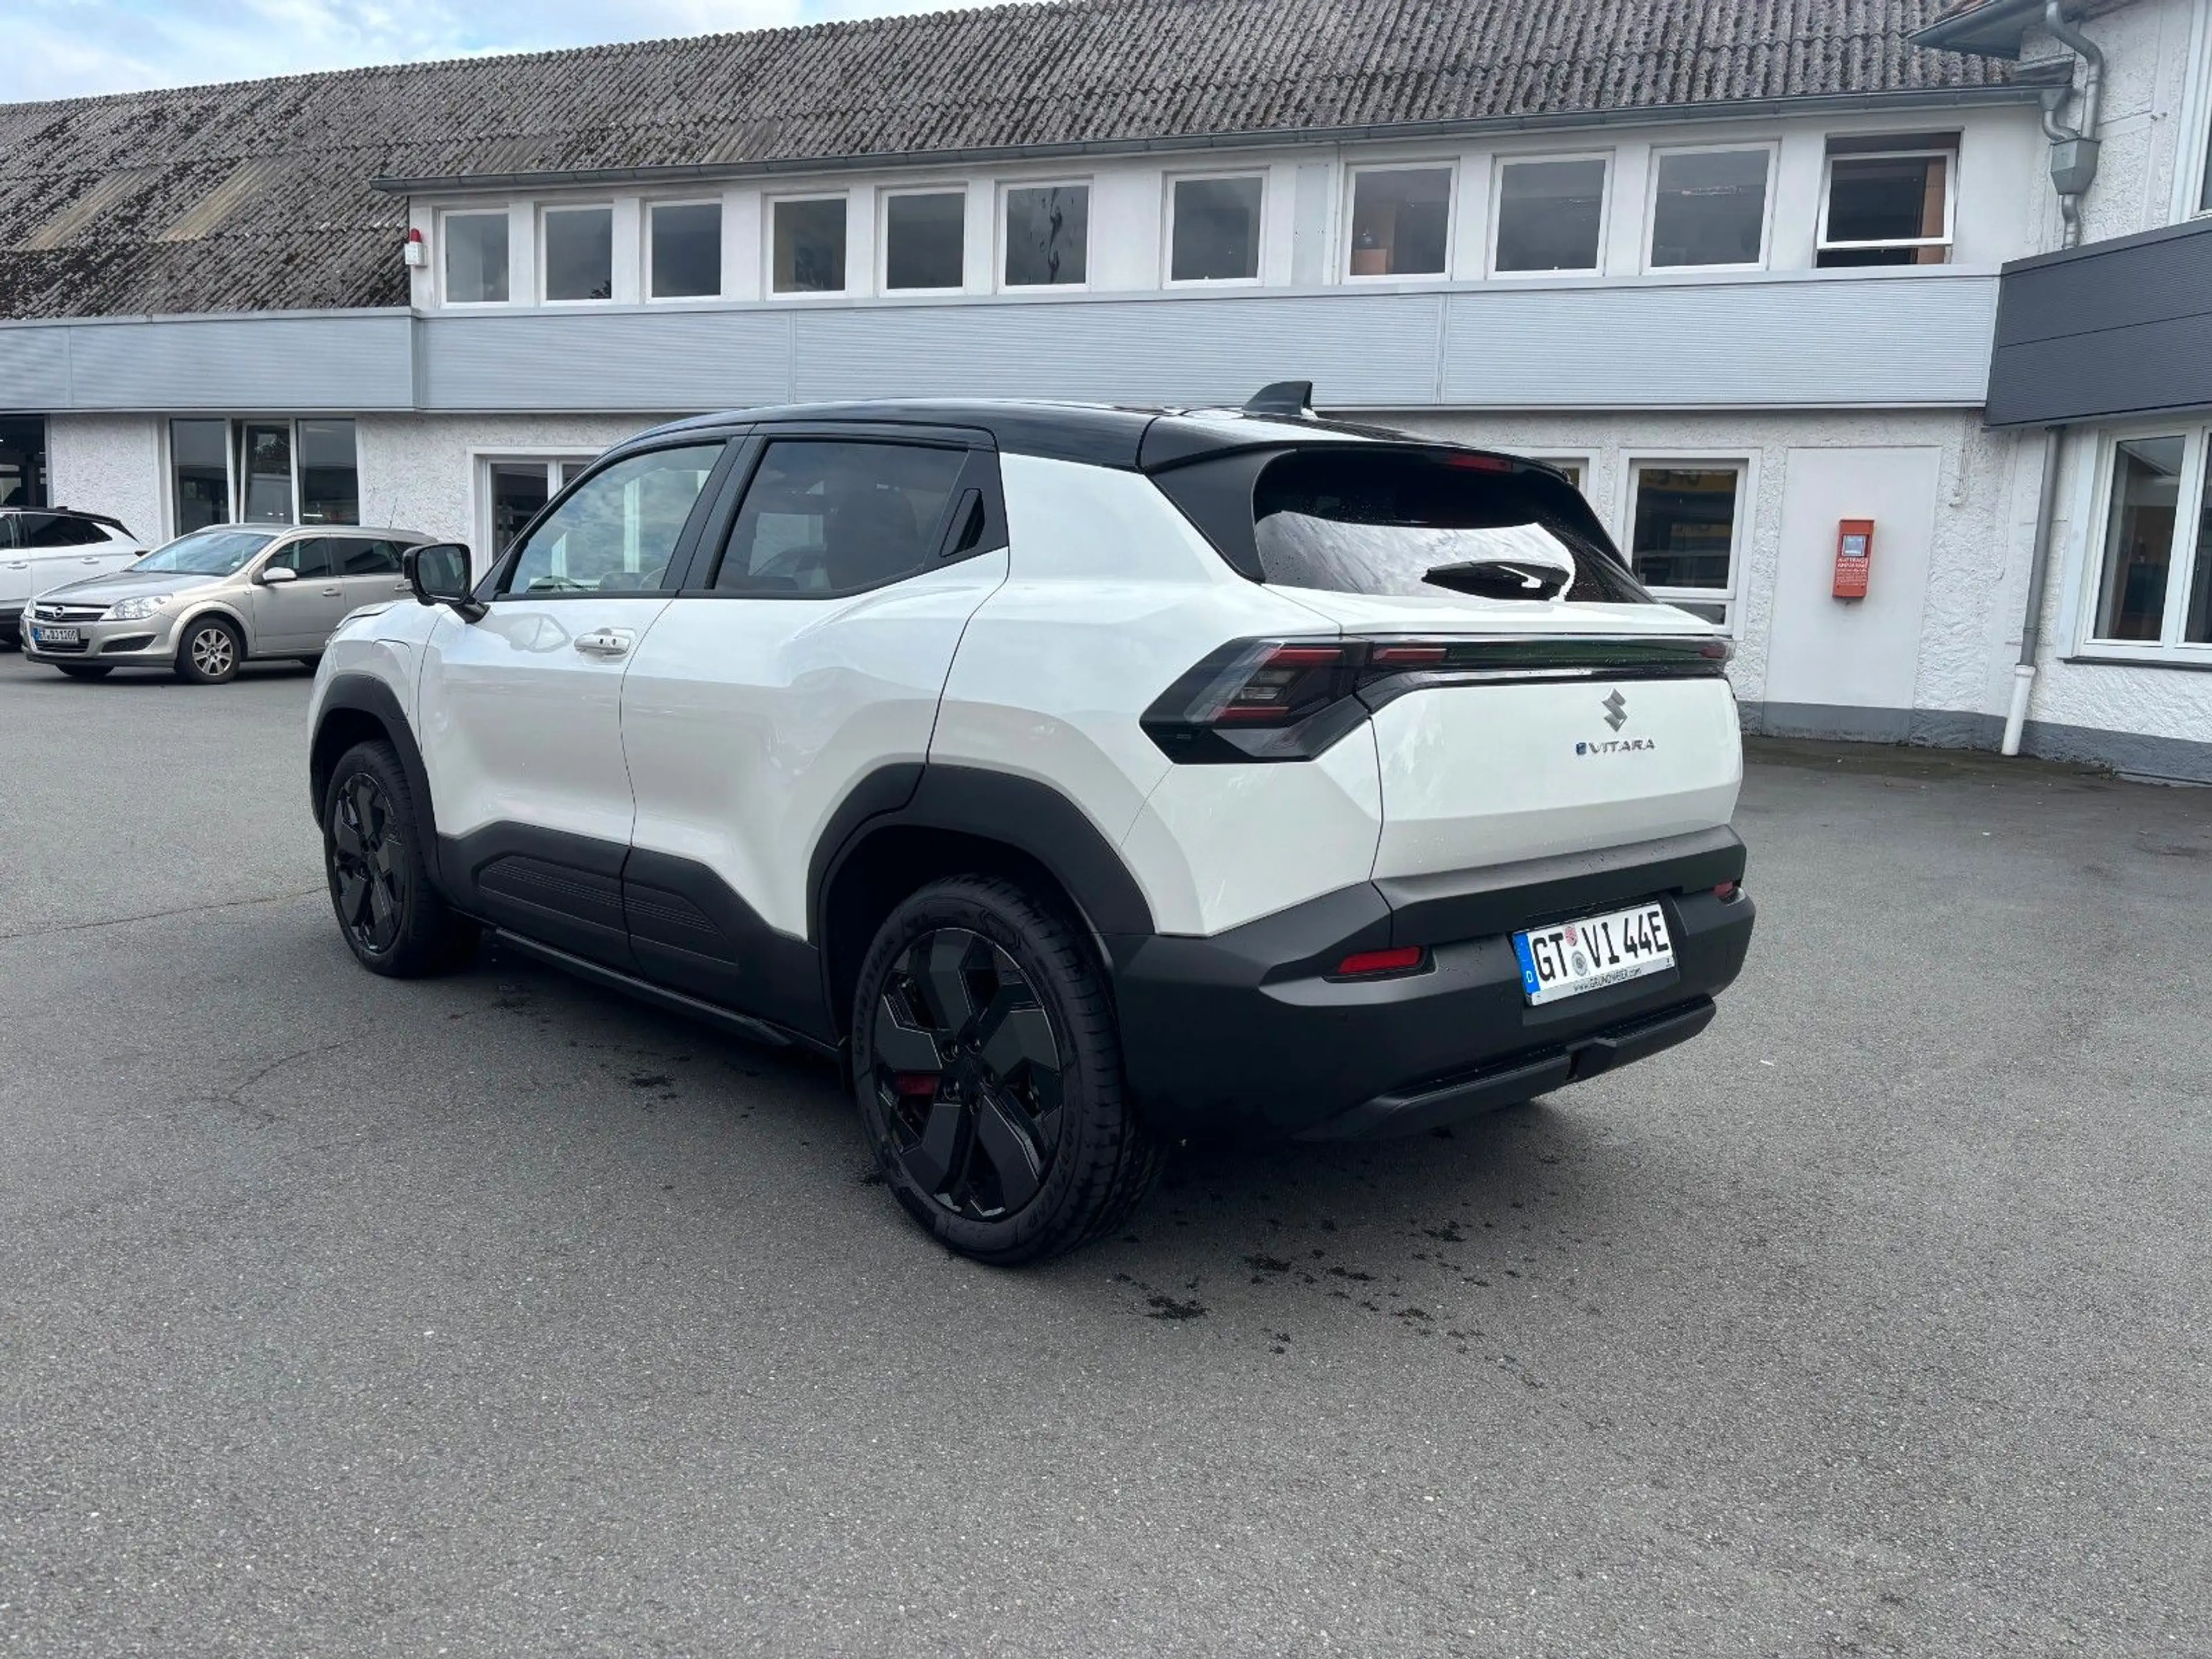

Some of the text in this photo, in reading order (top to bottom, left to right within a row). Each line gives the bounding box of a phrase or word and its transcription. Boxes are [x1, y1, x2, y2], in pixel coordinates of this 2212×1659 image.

[1532, 932, 1568, 982] GT
[1581, 922, 1620, 968] VI
[1623, 911, 1669, 959] 44E
